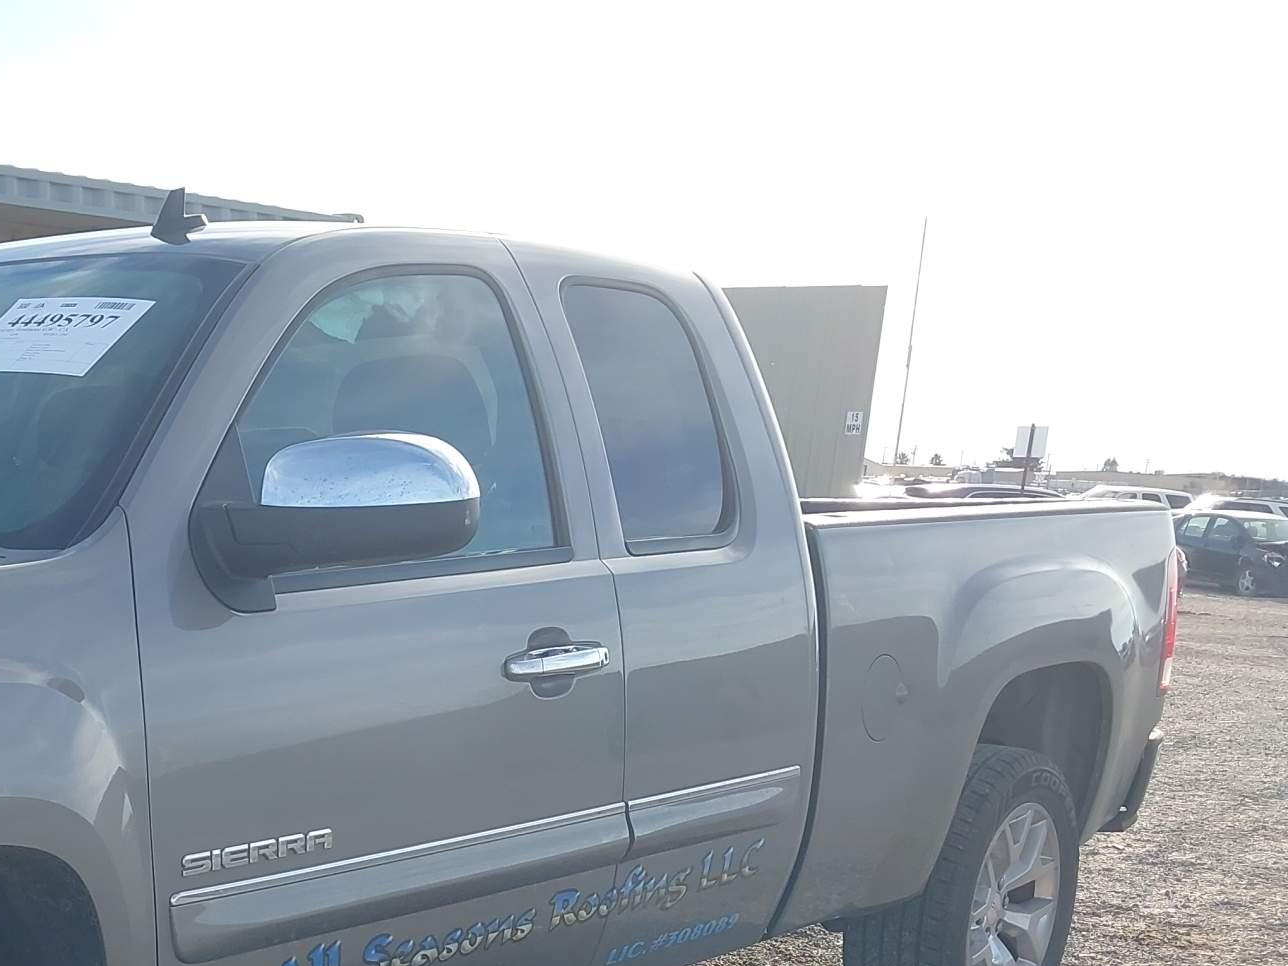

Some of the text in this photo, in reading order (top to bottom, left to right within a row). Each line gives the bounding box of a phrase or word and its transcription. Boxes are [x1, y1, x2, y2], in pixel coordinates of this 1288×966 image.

[7, 313, 120, 329] 44495797
[851, 412, 860, 423] 15
[846, 423, 861, 433] MPH
[182, 828, 333, 877] SIERRA
[549, 863, 693, 932] Roofing
[698, 837, 766, 892] LLC
